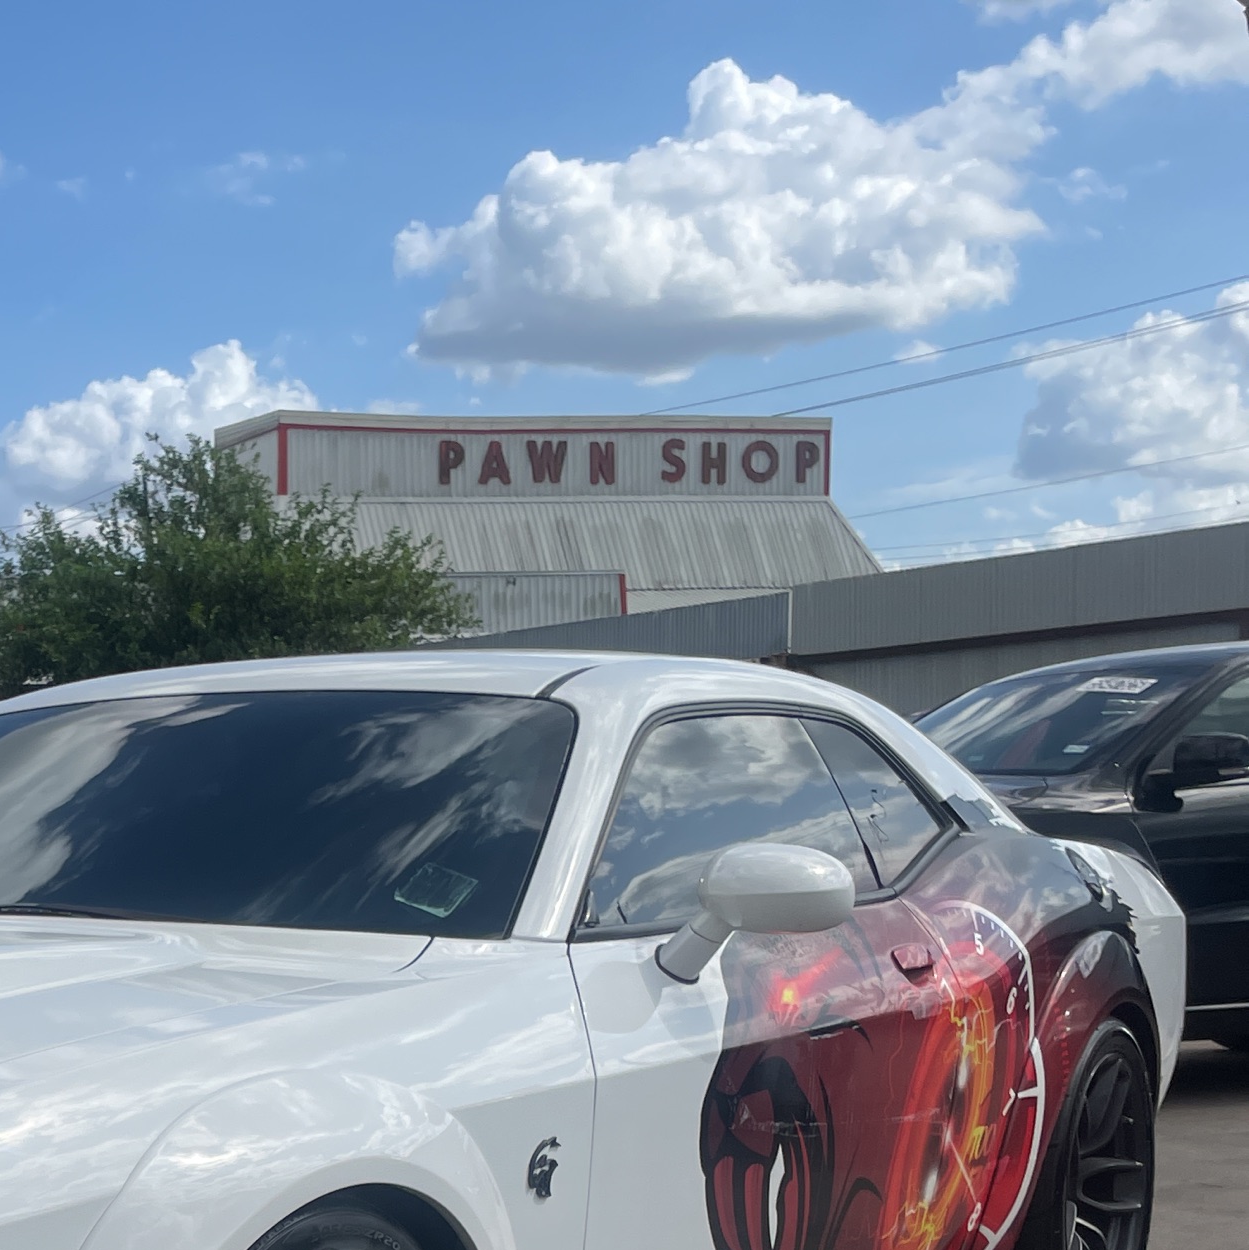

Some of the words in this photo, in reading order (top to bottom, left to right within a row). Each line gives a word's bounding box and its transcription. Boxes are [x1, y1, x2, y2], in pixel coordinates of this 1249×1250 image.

[438, 439, 615, 485] PAWN
[661, 438, 821, 485] SHOP
[974, 932, 985, 956] 5
[1006, 986, 1018, 1015] 6
[1002, 1087, 1016, 1117] 7
[967, 1201, 982, 1232] 8
